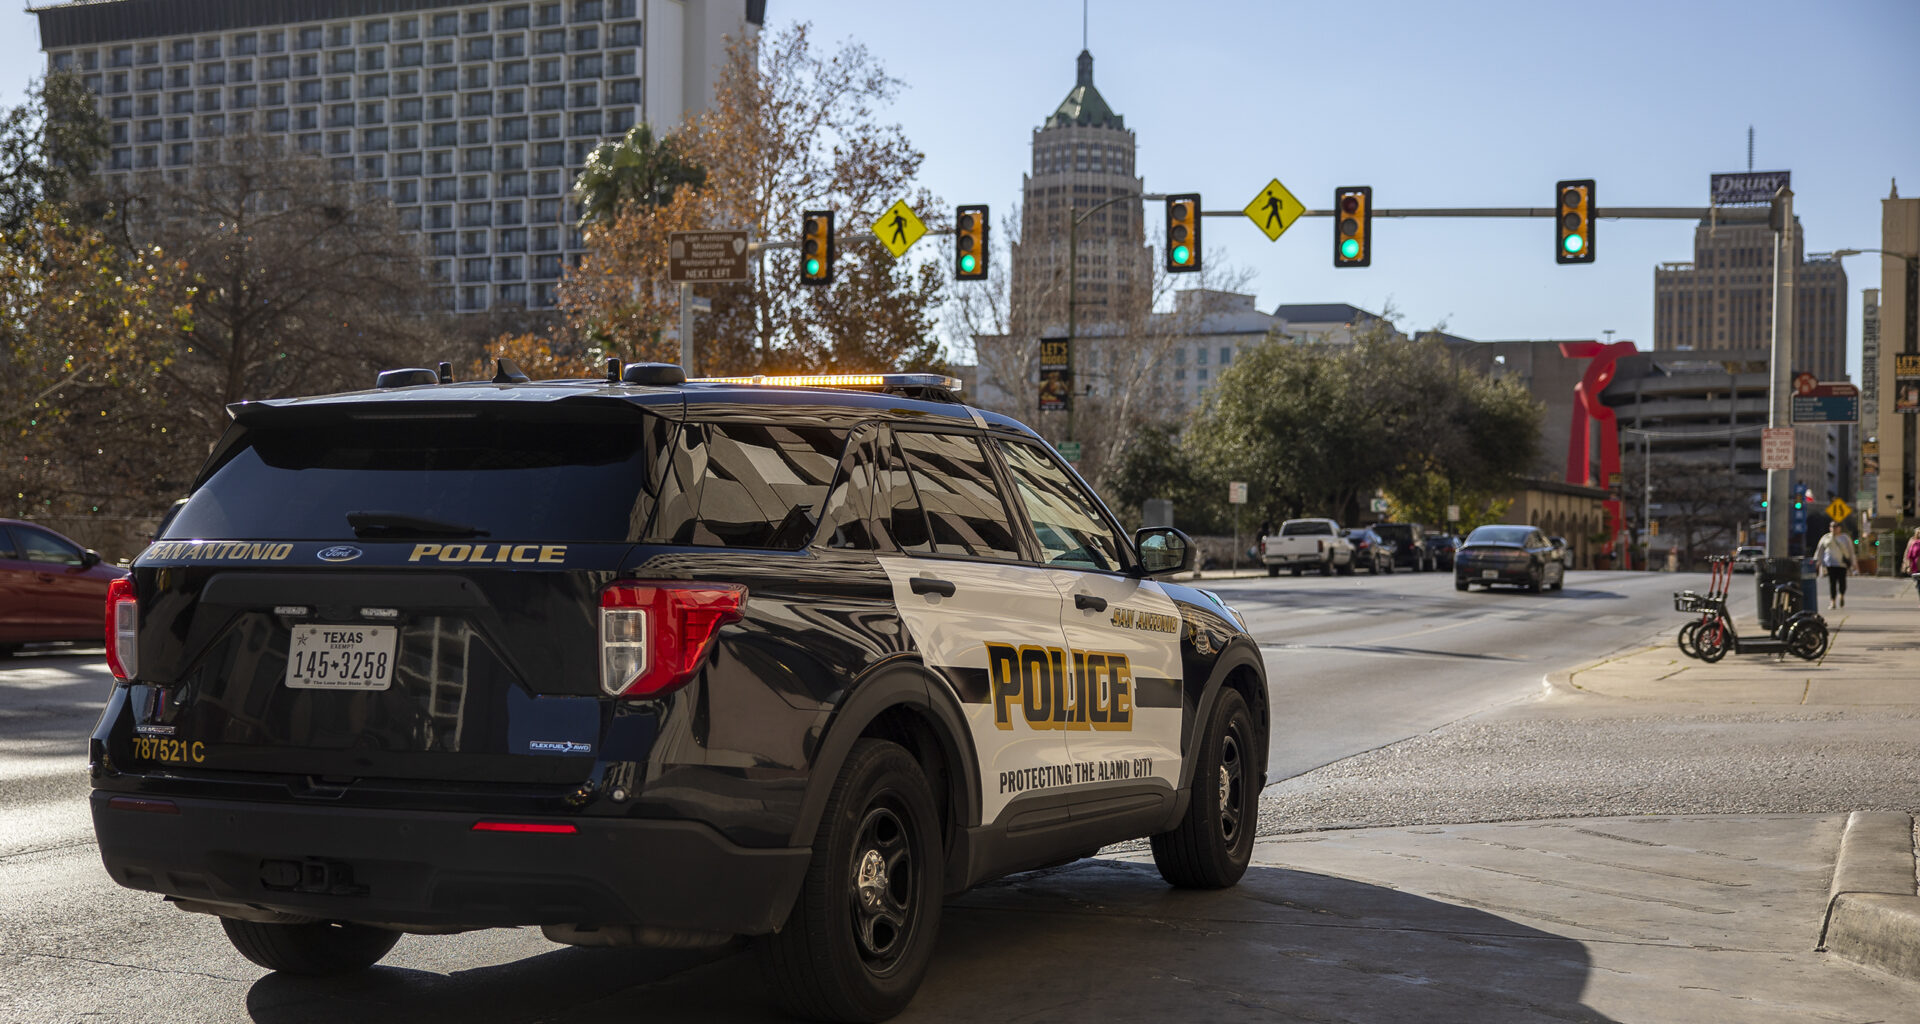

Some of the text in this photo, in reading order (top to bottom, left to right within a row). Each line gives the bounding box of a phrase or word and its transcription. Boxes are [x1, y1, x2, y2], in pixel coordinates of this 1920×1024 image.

[685, 268, 731, 278] NEXT LEFT
[147, 543, 294, 561] SAN ANTONIO
[325, 547, 353, 557] Ford
[408, 544, 568, 563] POLICE
[1110, 608, 1178, 633] SAN ANTONIO
[323, 632, 364, 643] TEXAS
[983, 641, 1133, 731] POLICE
[1000, 758, 1153, 793] PROTECTING THE ALAMO CITY
